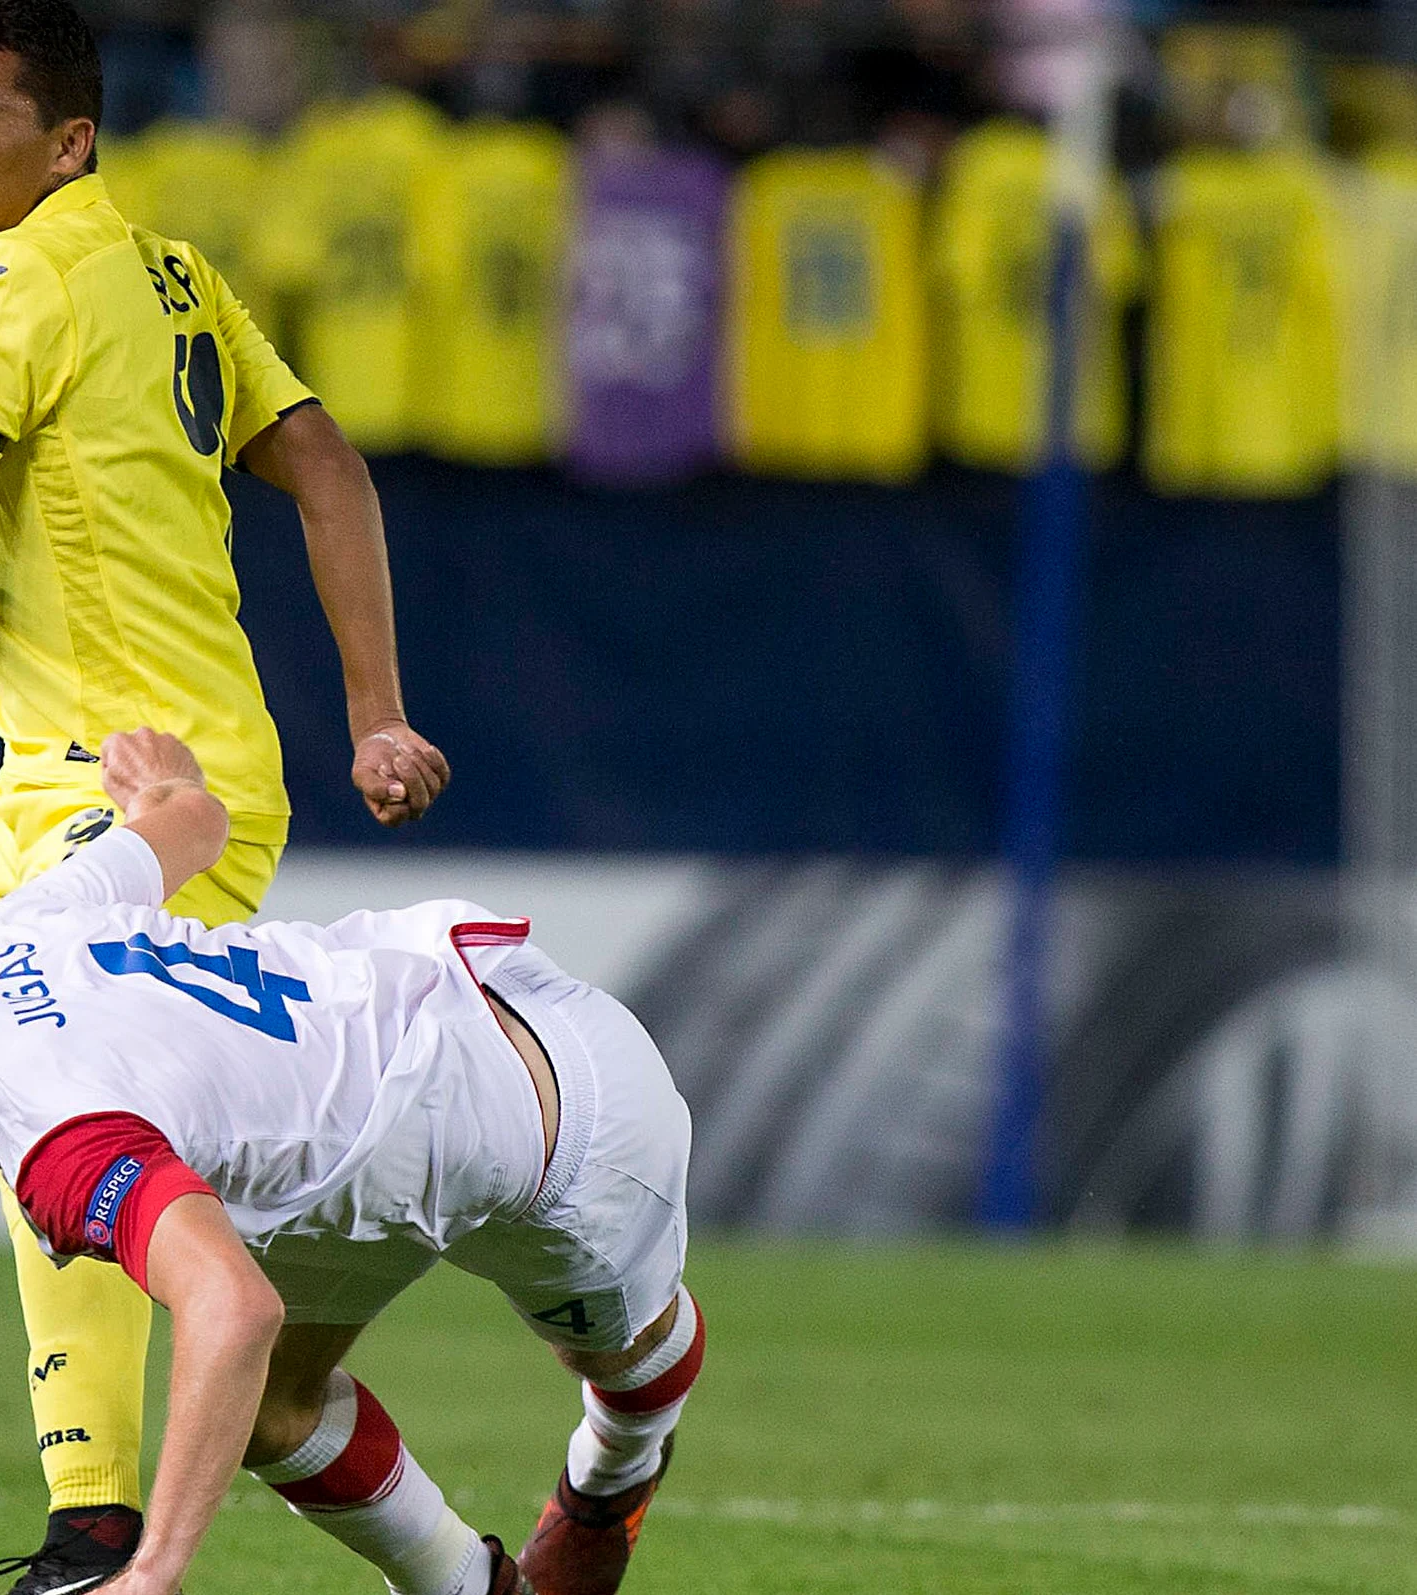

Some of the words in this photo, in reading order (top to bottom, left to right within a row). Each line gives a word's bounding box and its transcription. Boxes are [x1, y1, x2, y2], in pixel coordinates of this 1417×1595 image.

[88, 932, 312, 1043] 4
[95, 1158, 140, 1221] RESPECT
[531, 1298, 595, 1335] 4
